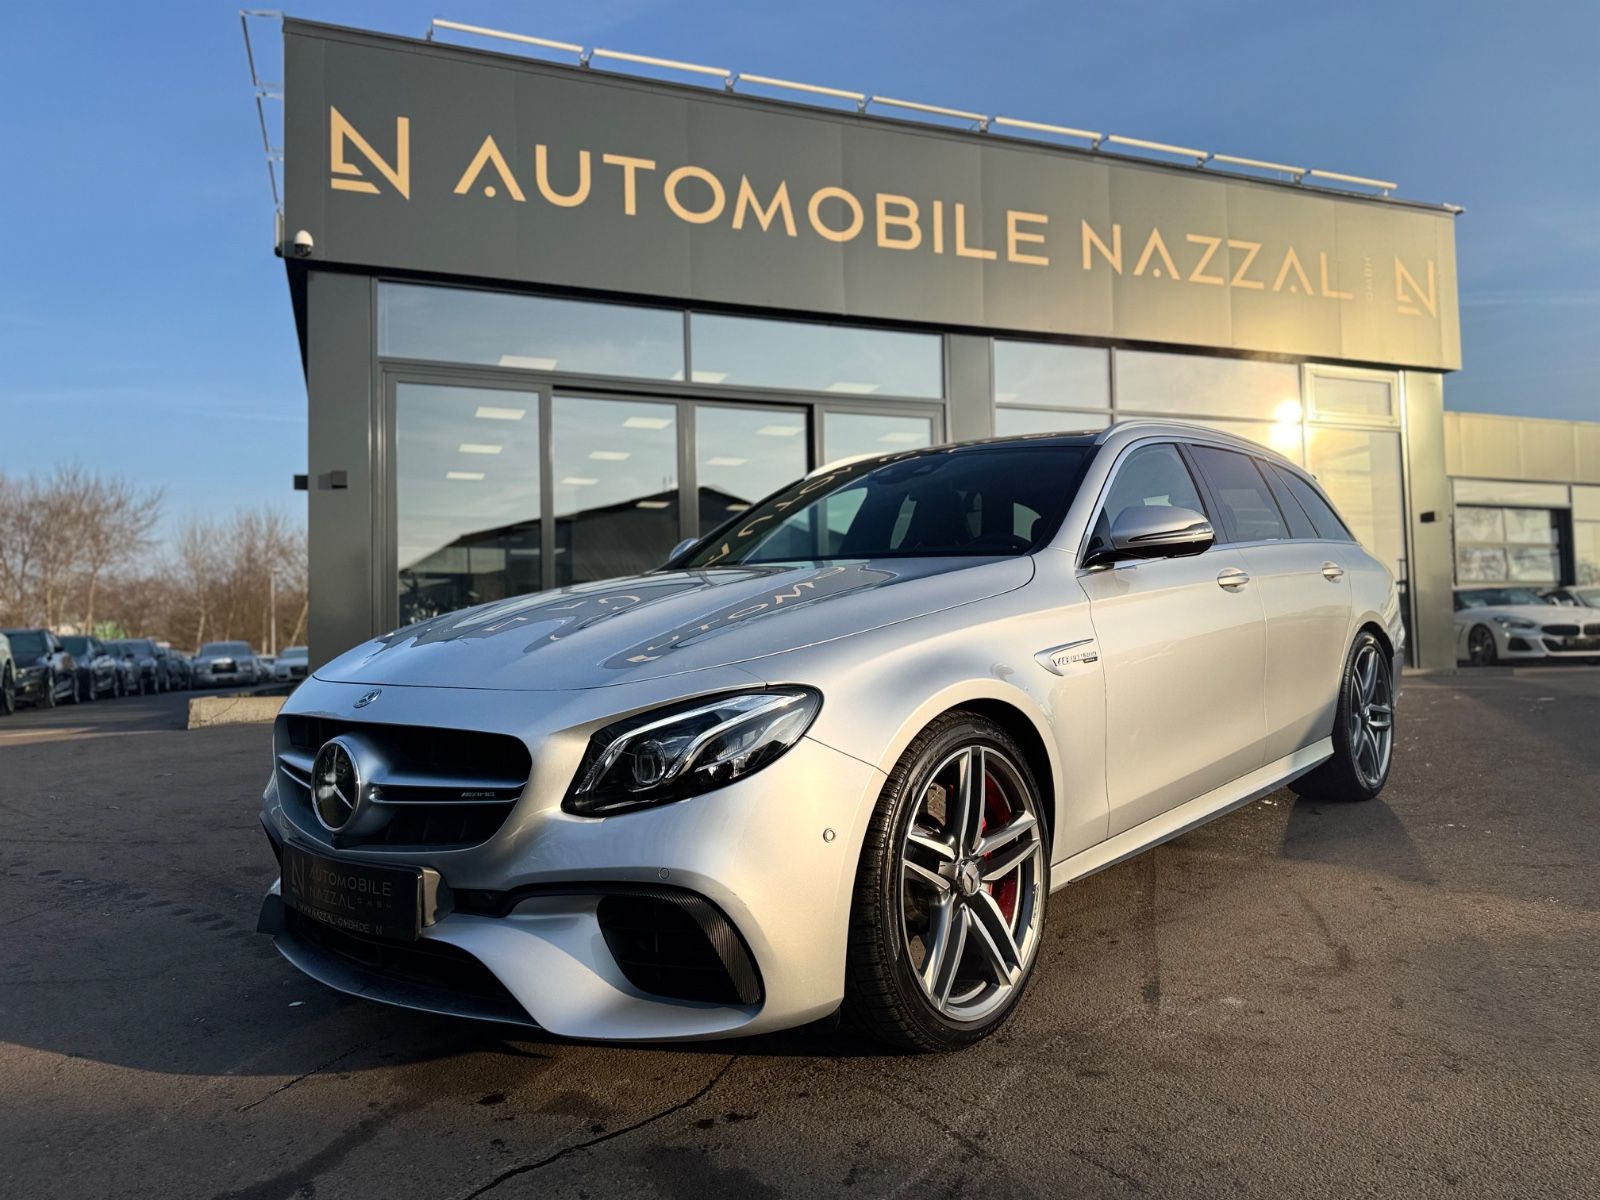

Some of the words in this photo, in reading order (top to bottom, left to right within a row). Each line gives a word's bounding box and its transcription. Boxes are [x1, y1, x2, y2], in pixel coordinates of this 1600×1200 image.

[453, 134, 1050, 267] AUTOMOBILE
[1080, 217, 1354, 300] NAZZAL
[308, 863, 393, 897] AUTOMOBILE
[309, 887, 356, 910] NAZZAL
